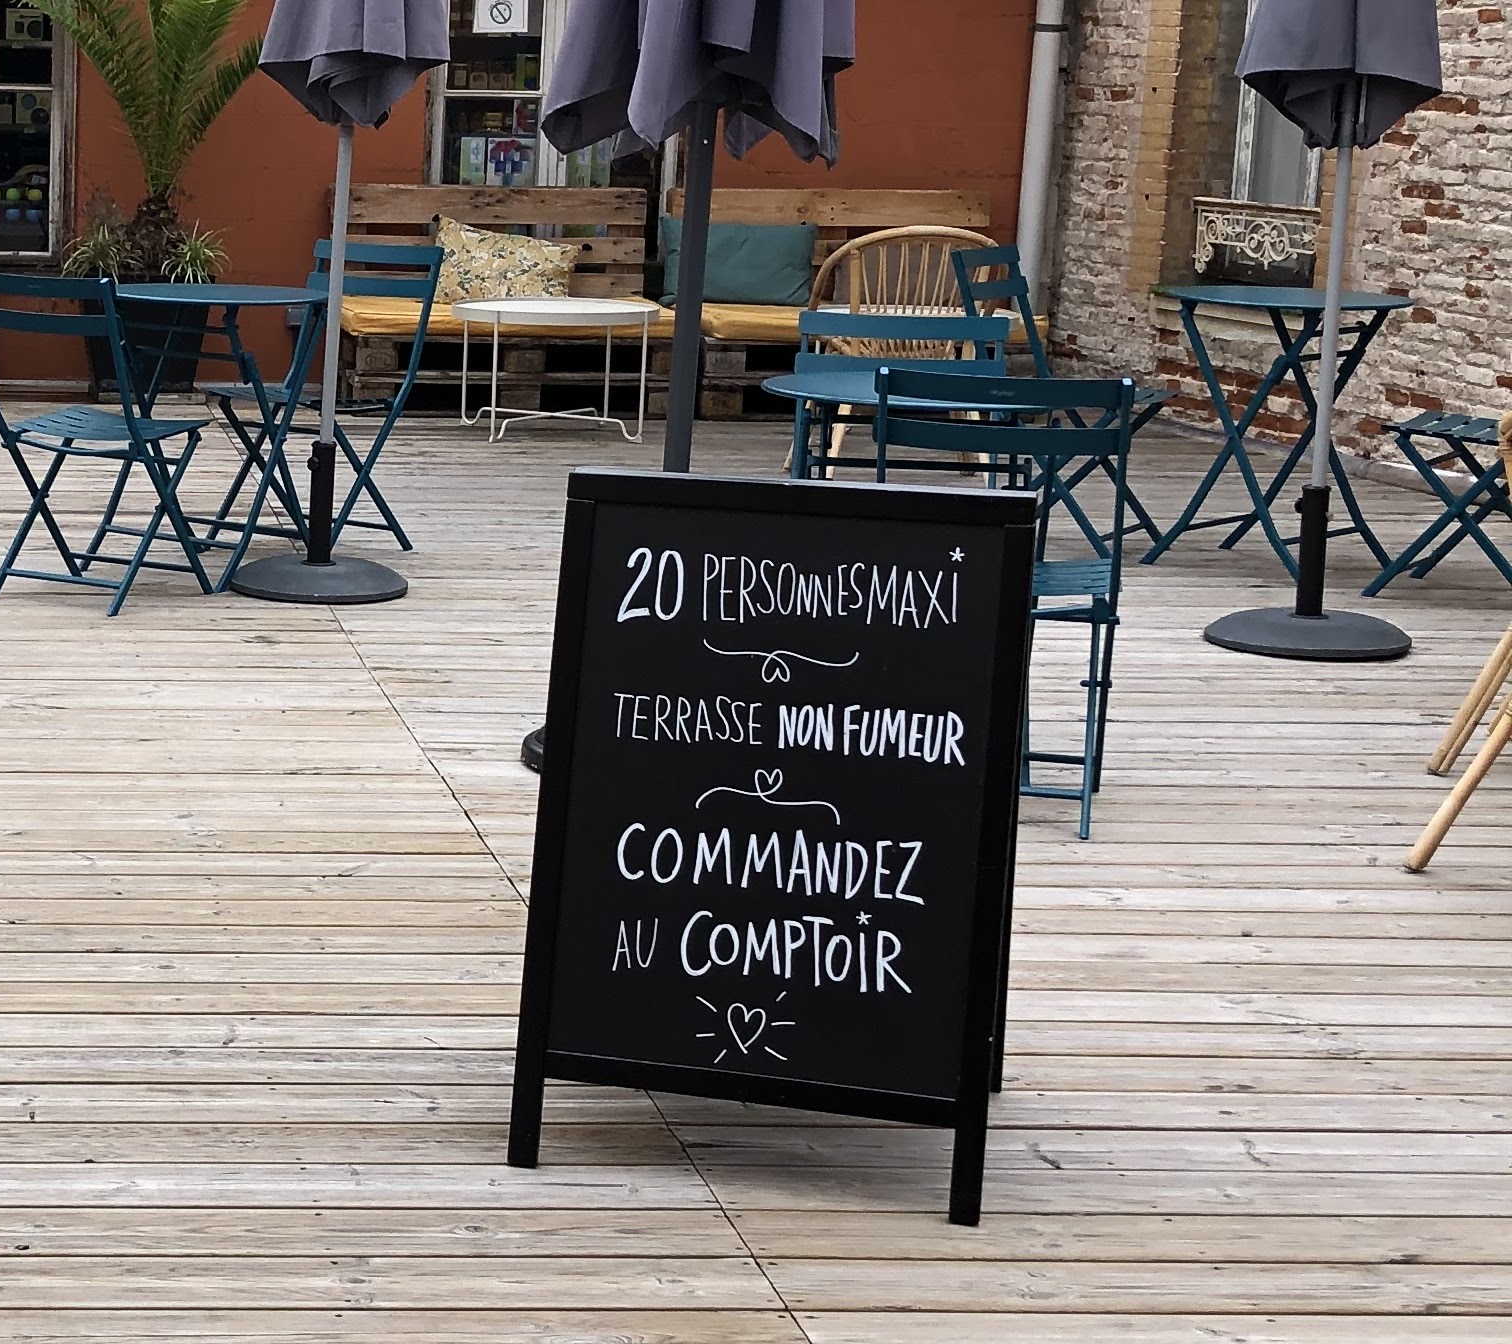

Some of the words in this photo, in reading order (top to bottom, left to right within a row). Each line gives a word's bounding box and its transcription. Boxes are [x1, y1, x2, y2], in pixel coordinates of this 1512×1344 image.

[616, 547, 685, 623] 20
[702, 553, 866, 624] PERSONNES
[613, 692, 763, 745] TERRASSE
[777, 703, 834, 752] NON
[843, 704, 966, 767] FUMEUR
[617, 822, 925, 906] COMMANDEZ
[611, 917, 659, 972] AU
